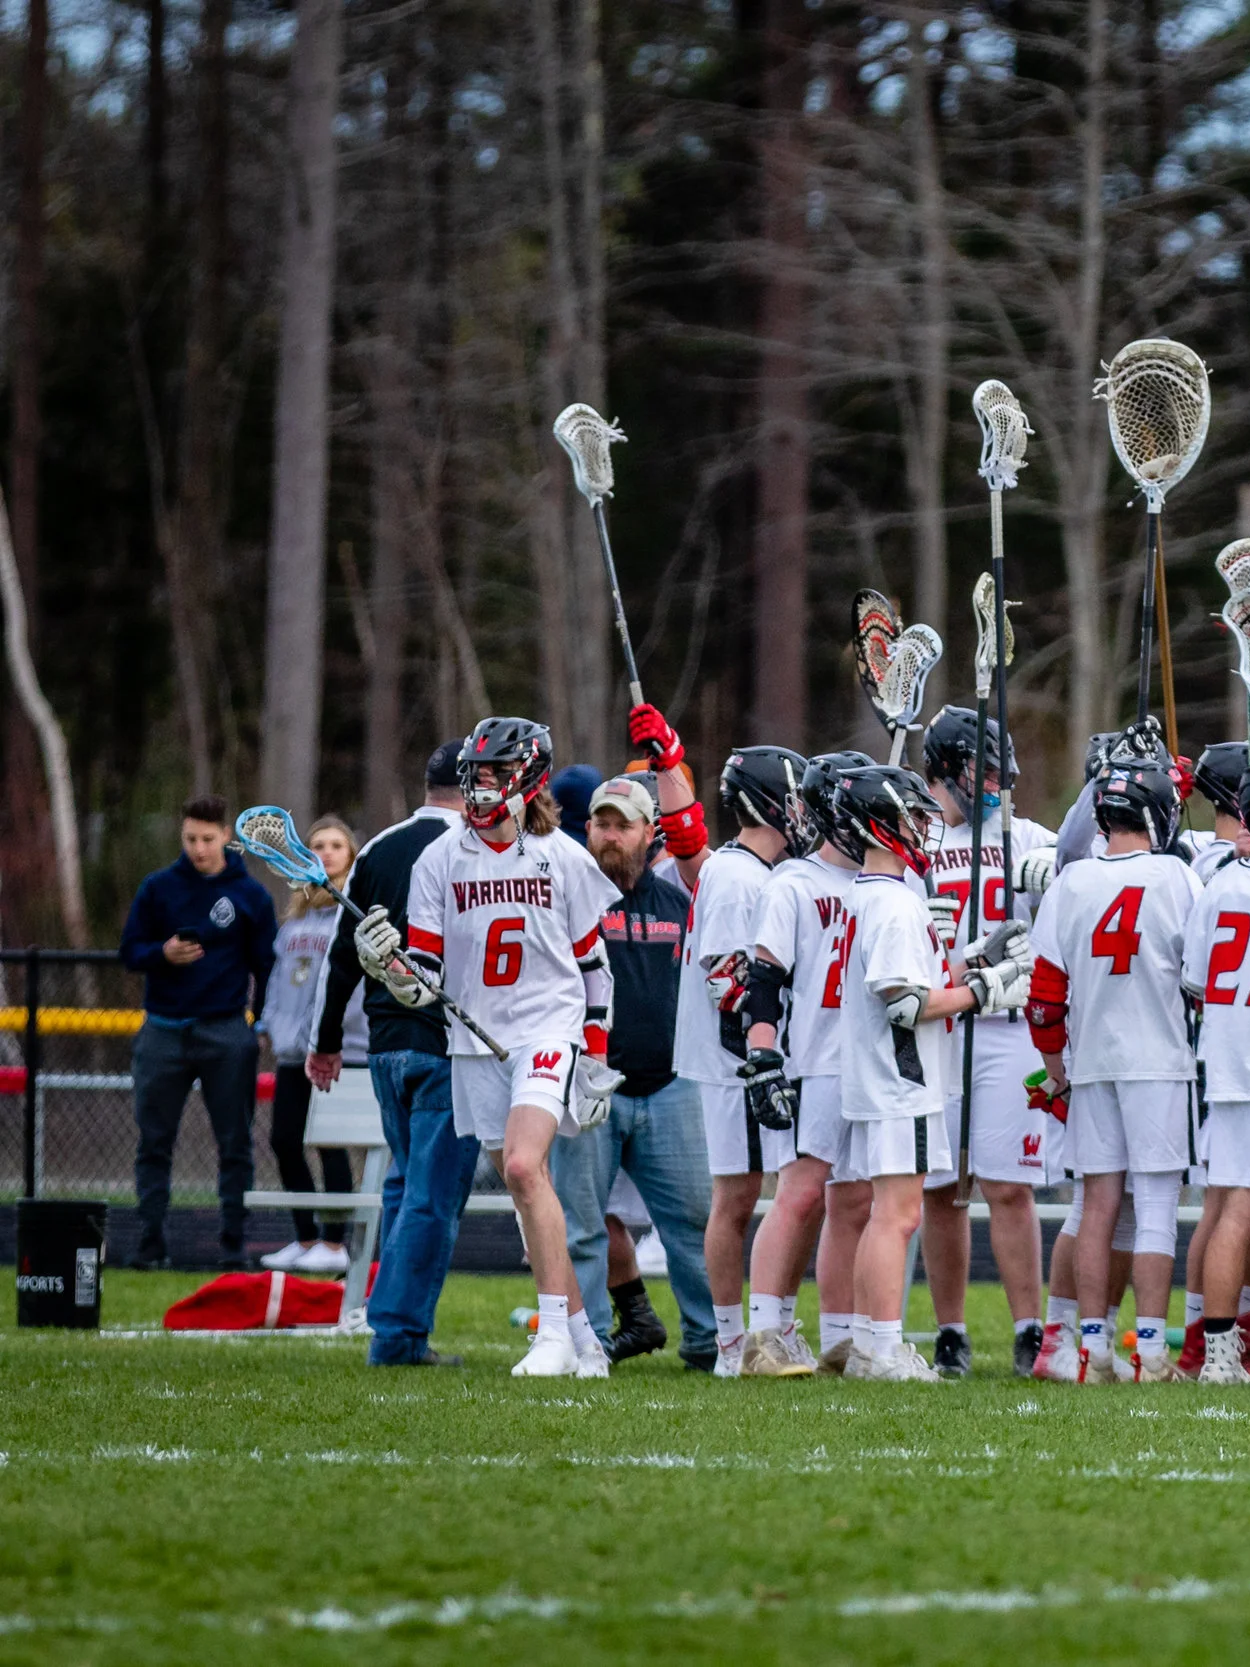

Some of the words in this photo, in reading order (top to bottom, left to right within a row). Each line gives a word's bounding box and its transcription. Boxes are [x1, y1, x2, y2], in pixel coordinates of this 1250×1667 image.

[452, 877, 552, 914] WARRIORS
[1091, 885, 1145, 976] 4
[483, 916, 526, 987] 6
